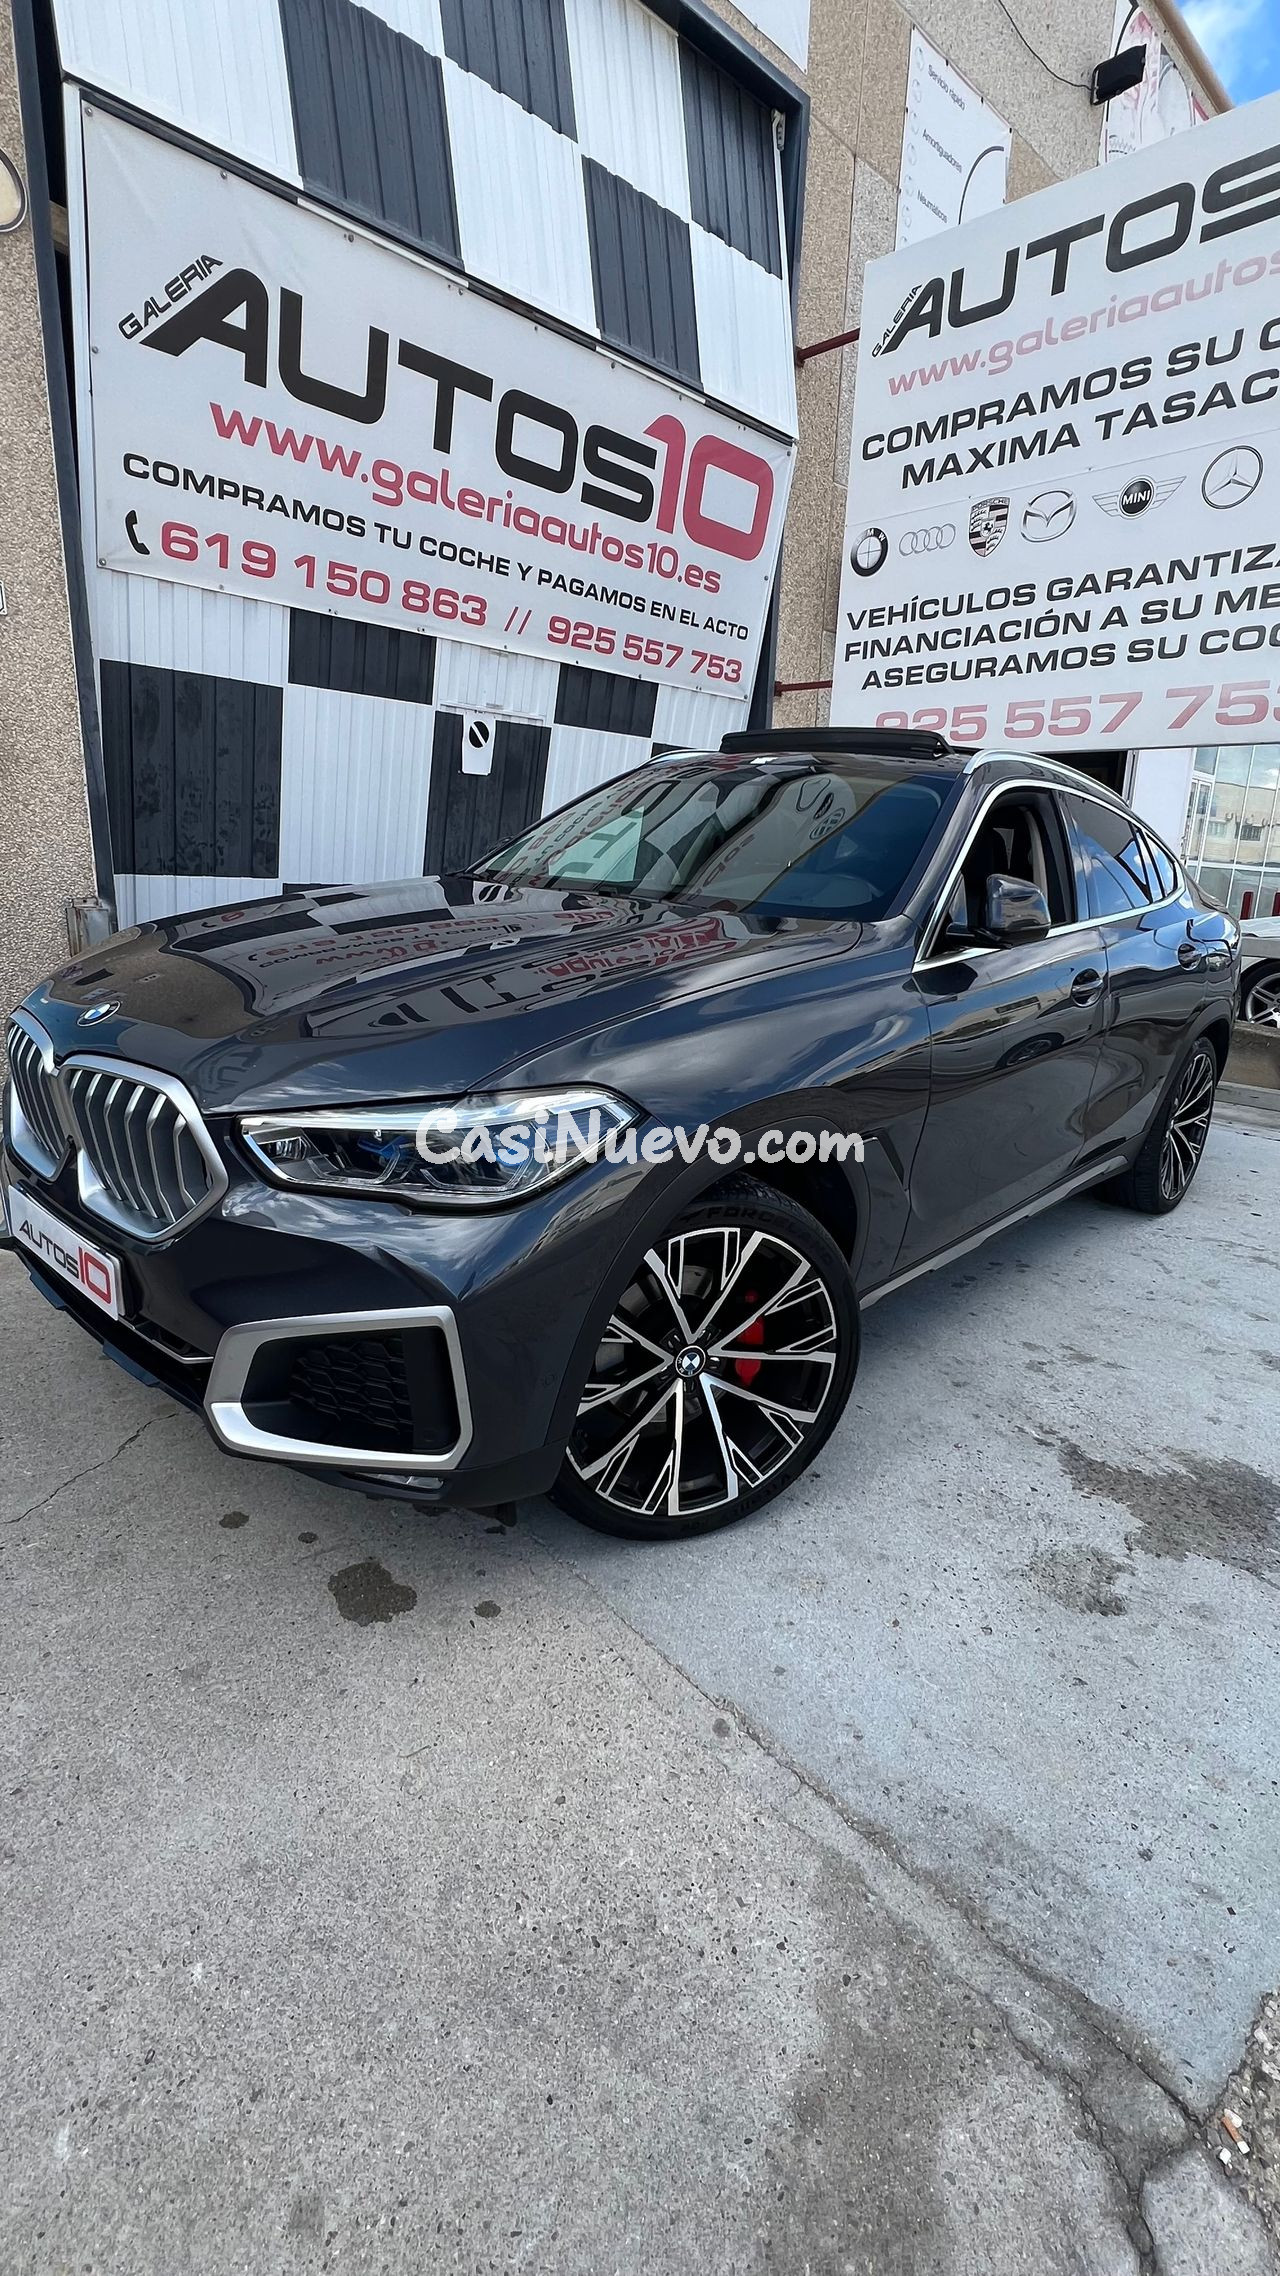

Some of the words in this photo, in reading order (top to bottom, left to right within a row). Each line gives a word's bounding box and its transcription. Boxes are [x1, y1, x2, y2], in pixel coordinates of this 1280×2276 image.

[118, 254, 223, 340] GALERIA
[872, 285, 922, 357] GALERIA
[139, 268, 775, 561] AUTOS10
[862, 356, 1152, 461] COMPRAMOS
[1166, 328, 1244, 377] SU
[902, 422, 1081, 489] MAXIMA
[1094, 368, 1280, 441] TASAC
[209, 402, 721, 594] www.galeriaautos10.es
[1122, 489, 1151, 505] MINI
[123, 453, 366, 538] COMPRAMOS
[374, 522, 412, 550] TU
[420, 536, 511, 577] COCHE
[517, 563, 533, 582] Y
[537, 568, 646, 614] PAGAMOS
[650, 602, 676, 621] EN
[679, 610, 699, 628] EL
[703, 617, 749, 640] ACTO
[847, 583, 1036, 631] VEHÍCULOS
[1046, 543, 1280, 602] GARANTIZ
[161, 521, 277, 579] 619
[294, 554, 391, 604] 150
[402, 580, 488, 626] 863
[547, 615, 617, 655] 925
[623, 633, 683, 669] 557
[690, 650, 743, 683] 753
[845, 608, 1091, 662] FINANCIACIÓN
[1099, 605, 1128, 630] A
[1140, 594, 1203, 625] SU
[861, 642, 1115, 690] ASEGURAMOS
[1127, 634, 1188, 663] SU
[1004, 691, 1143, 739] 557
[1166, 680, 1280, 730] 75
[19, 1220, 112, 1304] AUTOS10
